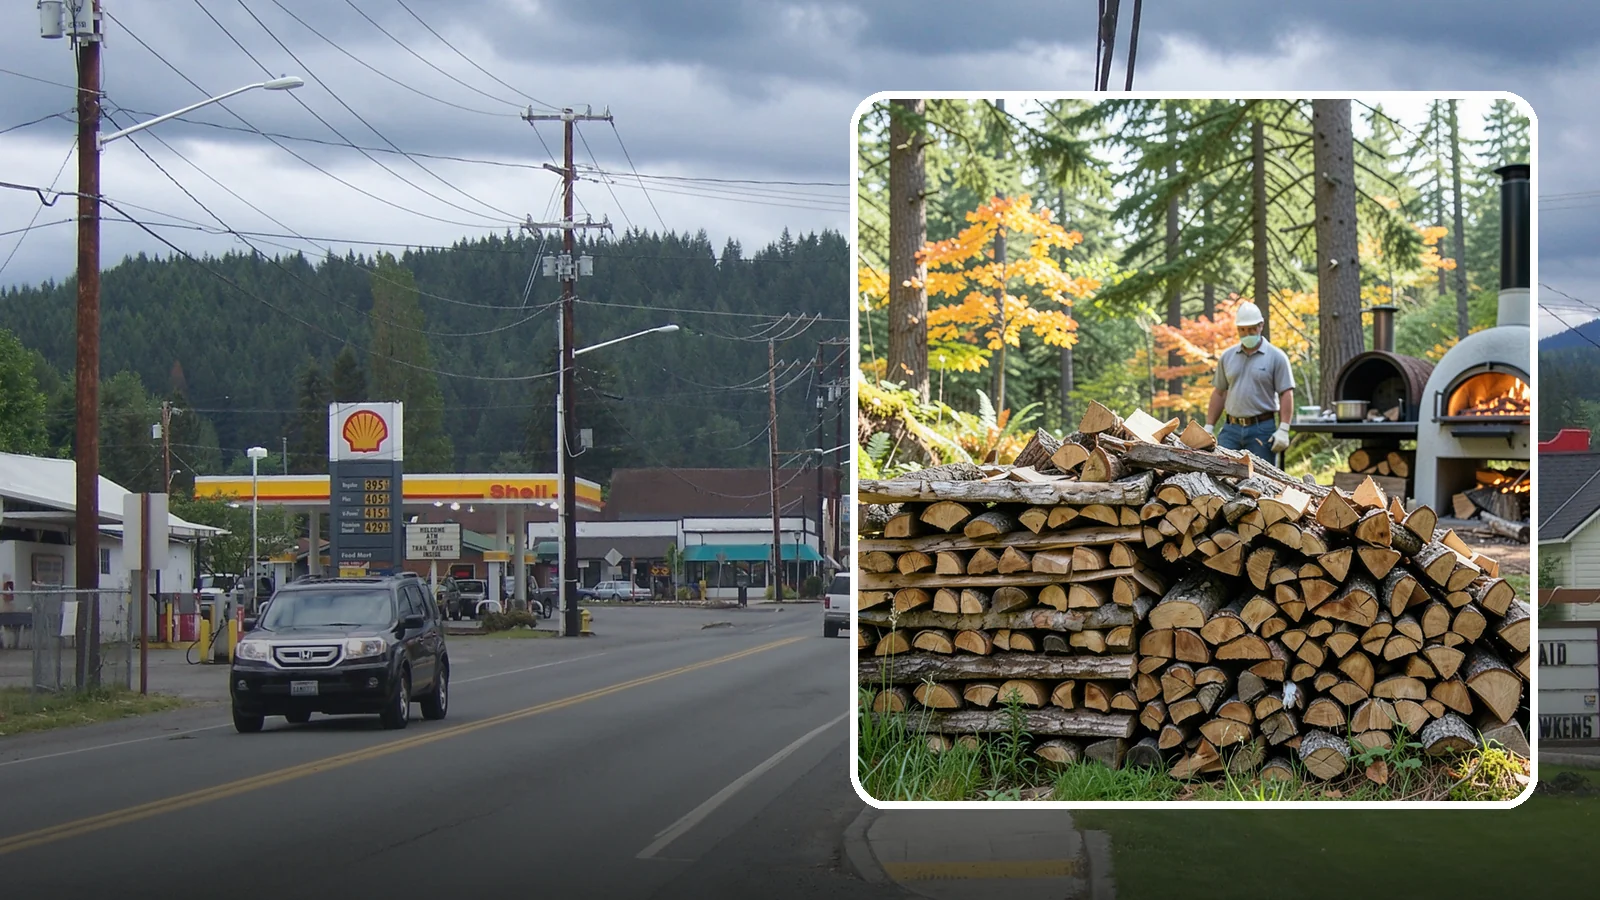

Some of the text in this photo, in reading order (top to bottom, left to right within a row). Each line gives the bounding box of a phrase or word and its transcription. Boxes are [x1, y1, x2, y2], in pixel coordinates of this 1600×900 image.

[365, 480, 384, 490] 395
[490, 484, 547, 499] Shell
[365, 494, 384, 504] 405
[365, 508, 384, 518] 415
[365, 522, 384, 533] 429
